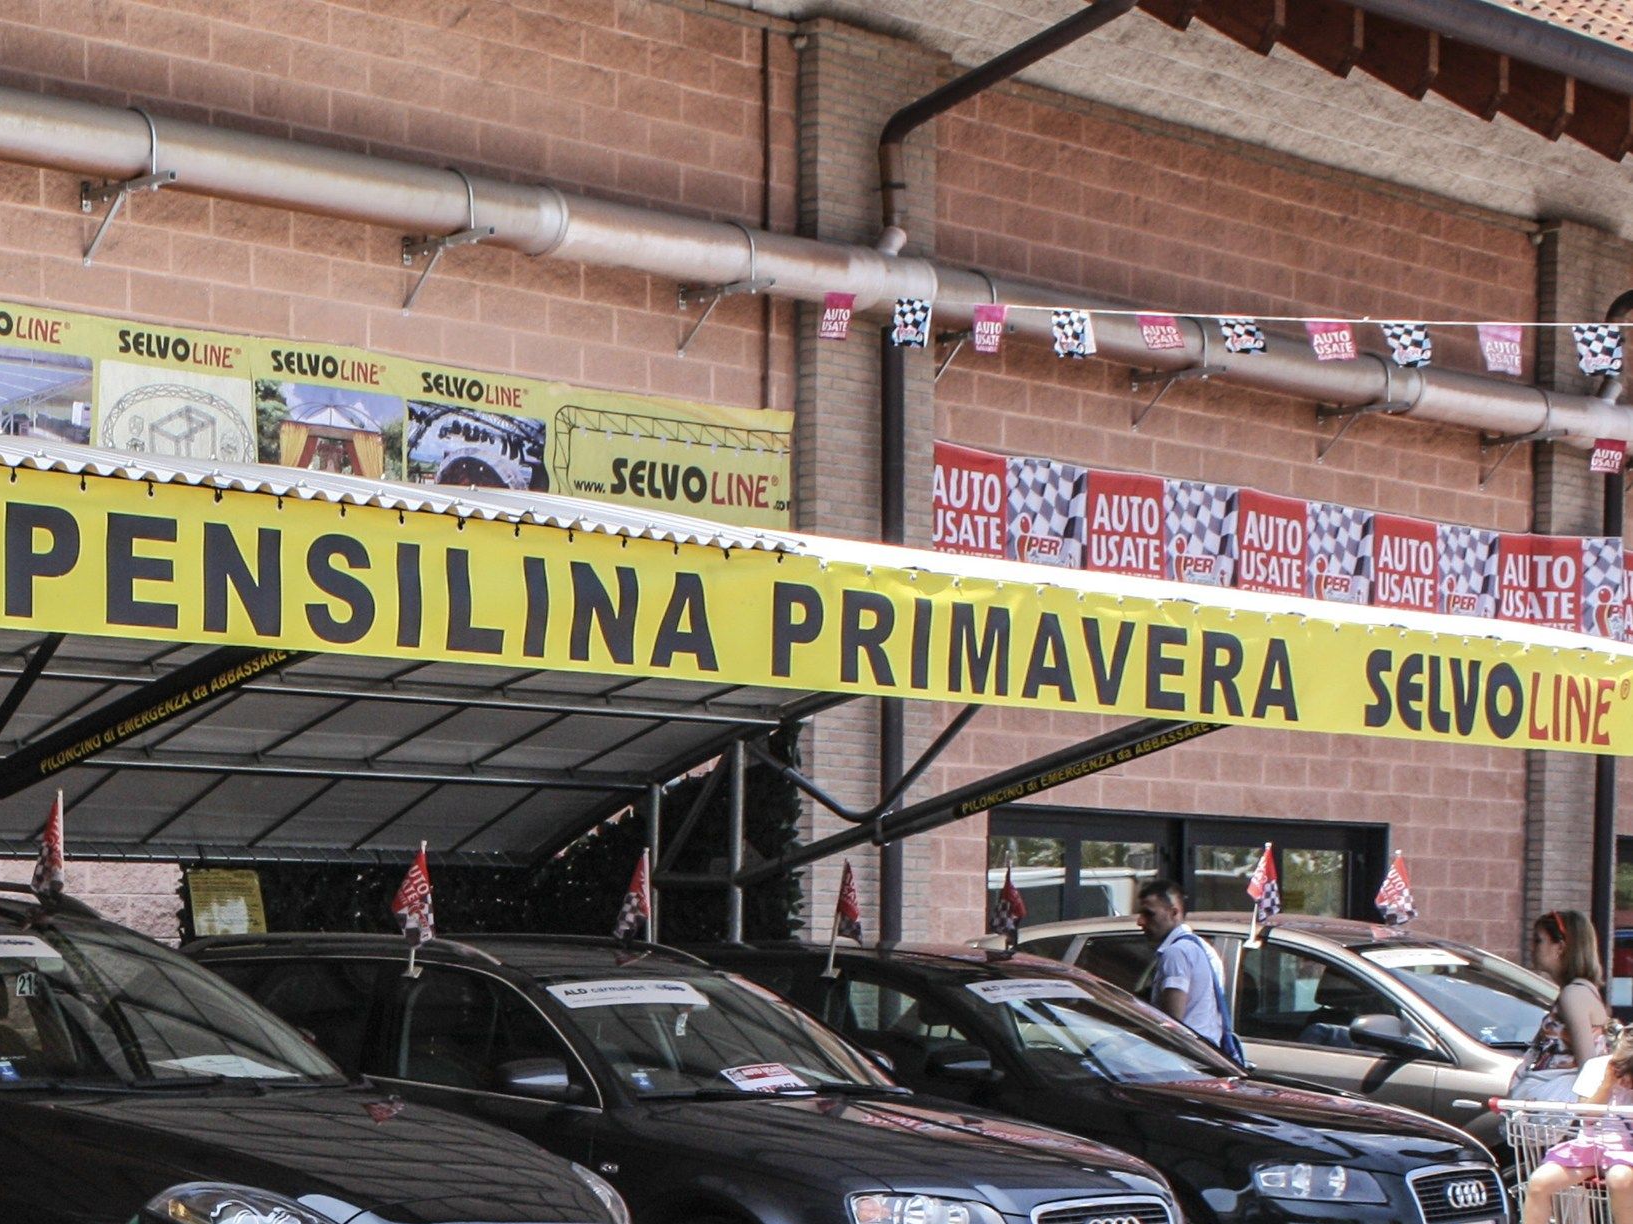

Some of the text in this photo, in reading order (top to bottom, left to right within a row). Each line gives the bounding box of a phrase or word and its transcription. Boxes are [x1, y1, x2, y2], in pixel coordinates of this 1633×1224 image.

[824, 308, 850, 321] AUTO
[975, 321, 1002, 334] AUTO
[1143, 325, 1177, 336] AUTO
[1313, 330, 1349, 345] AUTO
[1485, 341, 1521, 355] AUTO
[933, 464, 1001, 514] AUTO
[1093, 493, 1160, 535] AUTO
[1242, 511, 1303, 555] AUTO
[1091, 535, 1161, 571] USATE
[1241, 550, 1302, 589] USATE
[1378, 534, 1434, 576] AUTO
[1503, 553, 1576, 589] AUTO
[1377, 571, 1434, 608] USATE
[1501, 589, 1575, 620] USATE
[4, 502, 719, 672] PENSILINA
[771, 581, 1299, 723] PRIMAVERA
[117, 694, 190, 737] EMERGENZA
[193, 685, 208, 699] da
[1041, 753, 1114, 787] EMERGENZA
[408, 865, 429, 895] UTO
